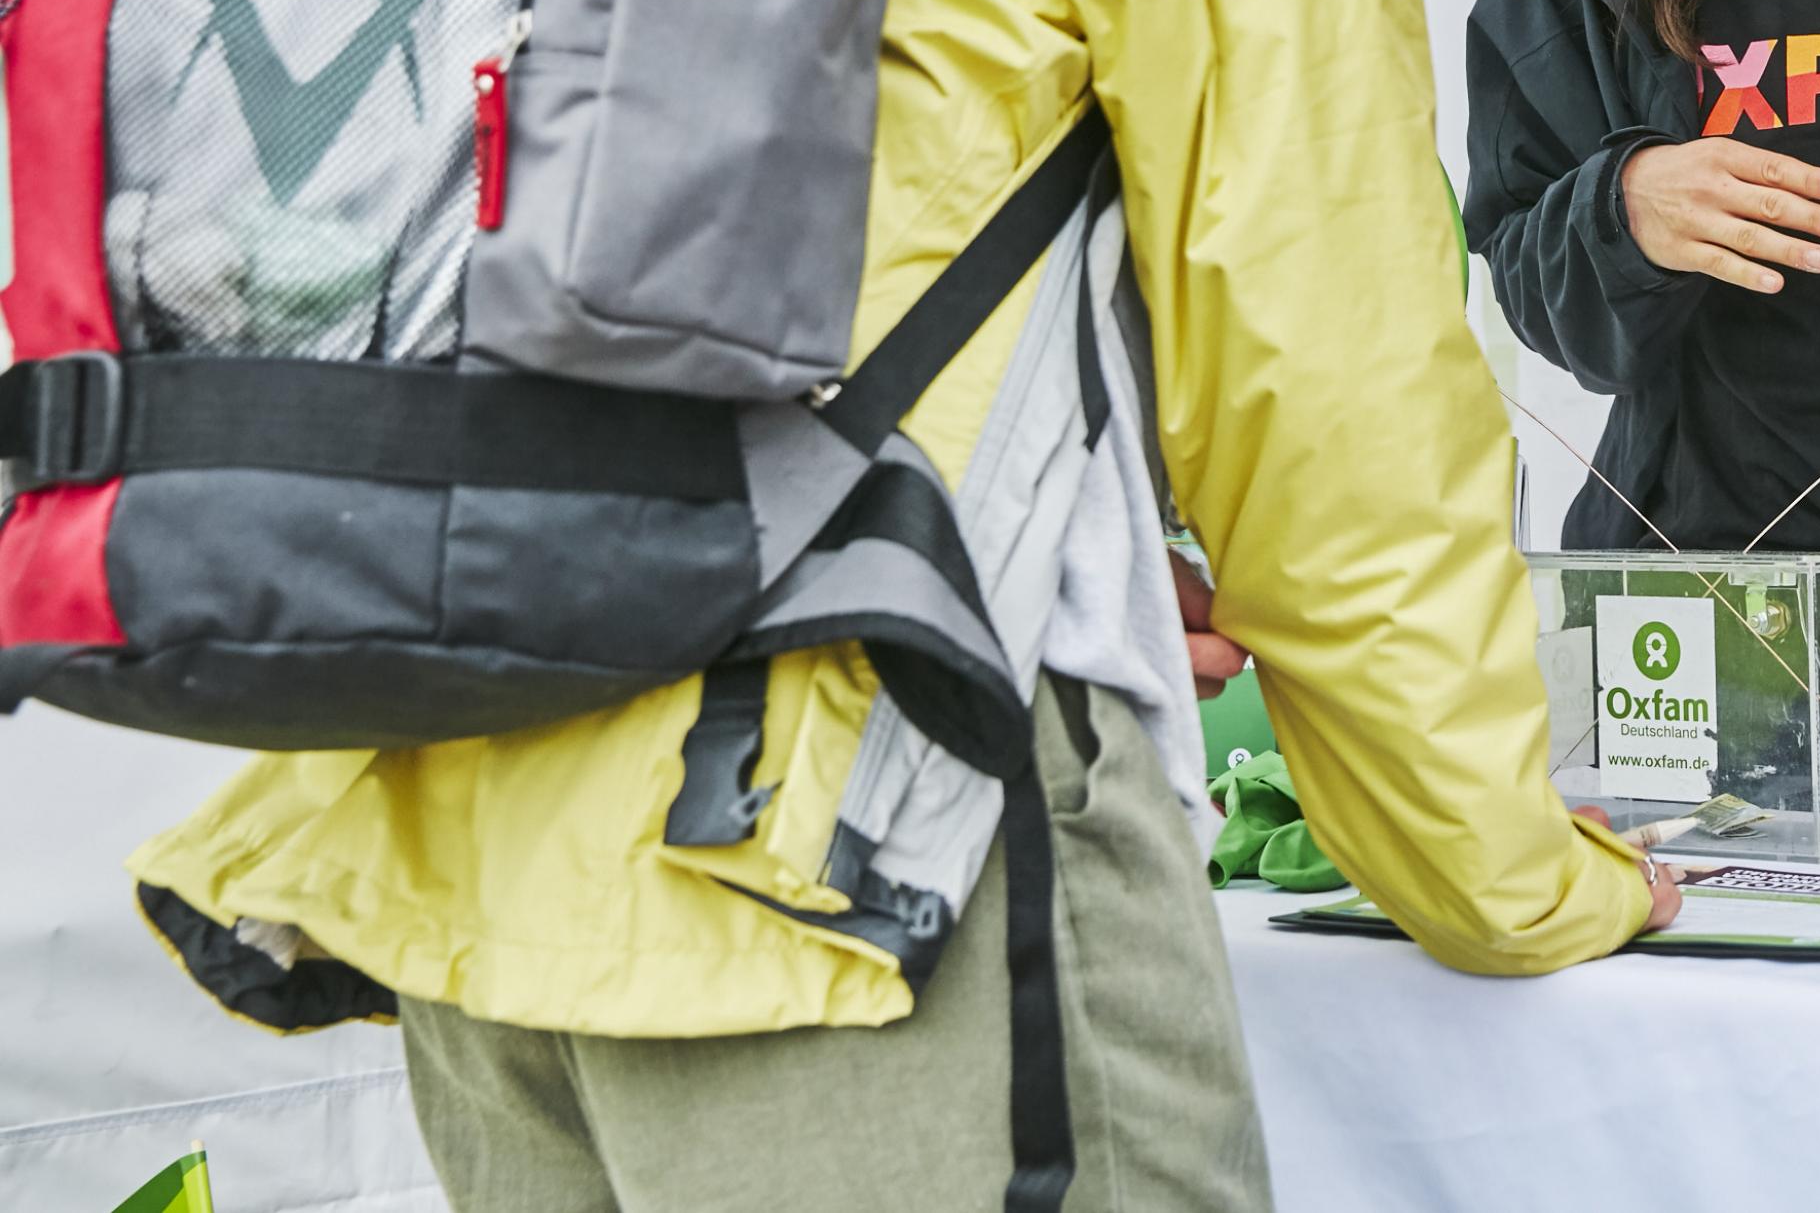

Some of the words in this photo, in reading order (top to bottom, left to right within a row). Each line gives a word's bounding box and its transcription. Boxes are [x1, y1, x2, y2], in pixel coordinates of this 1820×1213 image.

[1606, 687, 1709, 722] Oxfam
[1620, 723, 1698, 739] Deutschland
[1607, 754, 1710, 770] www.oxfam.de
